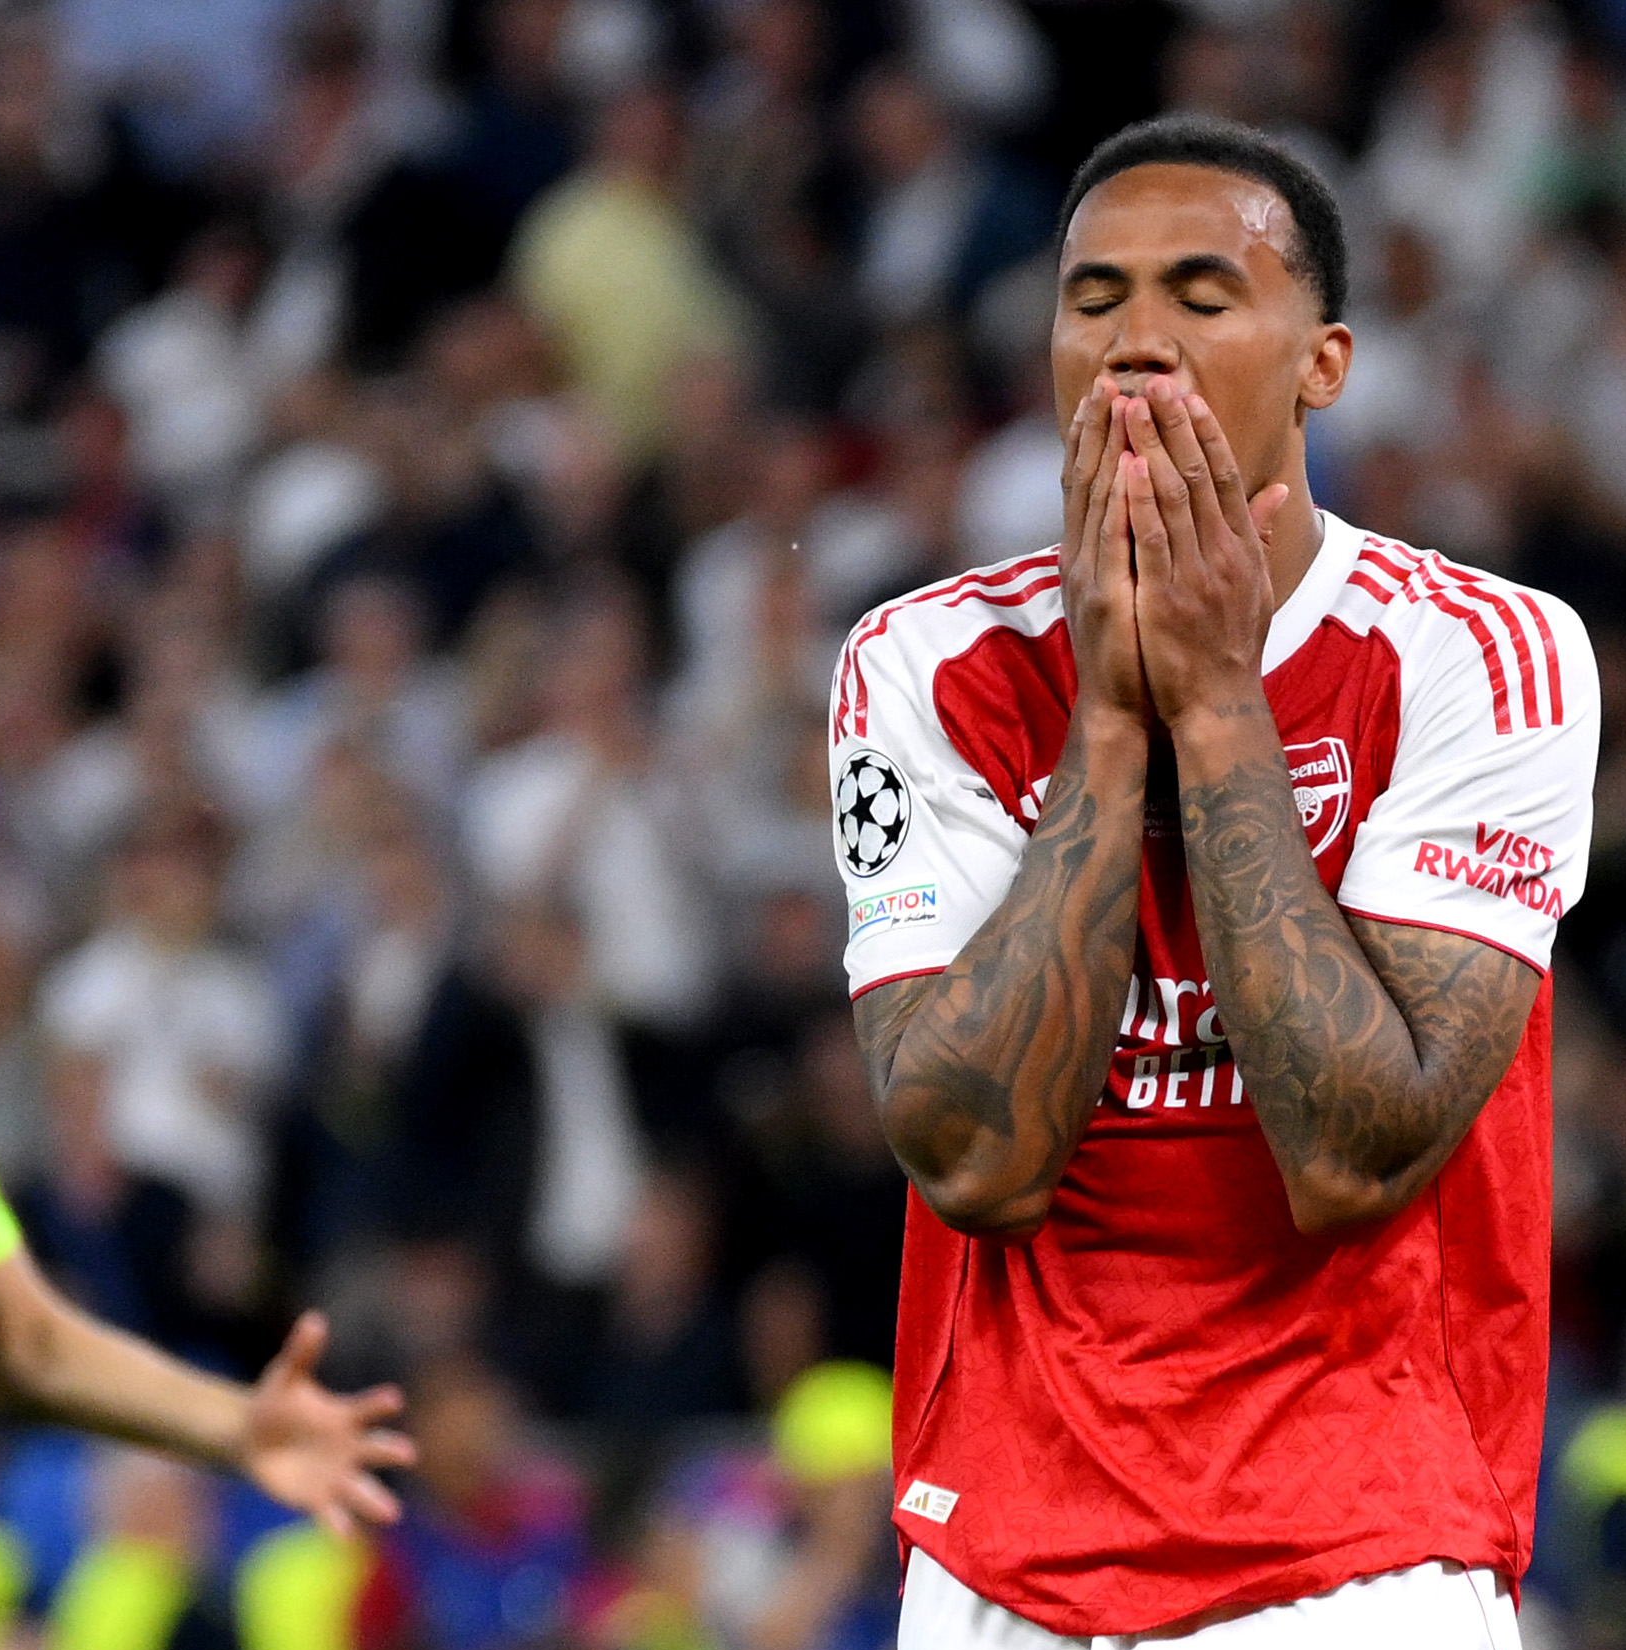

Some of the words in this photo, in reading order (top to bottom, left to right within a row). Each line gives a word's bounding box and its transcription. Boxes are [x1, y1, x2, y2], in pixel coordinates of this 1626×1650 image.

[1289, 754, 1335, 780] senal
[1475, 821, 1554, 873] VISIT
[1414, 841, 1563, 920] RWANDA
[1127, 1046, 1244, 1109] BET
